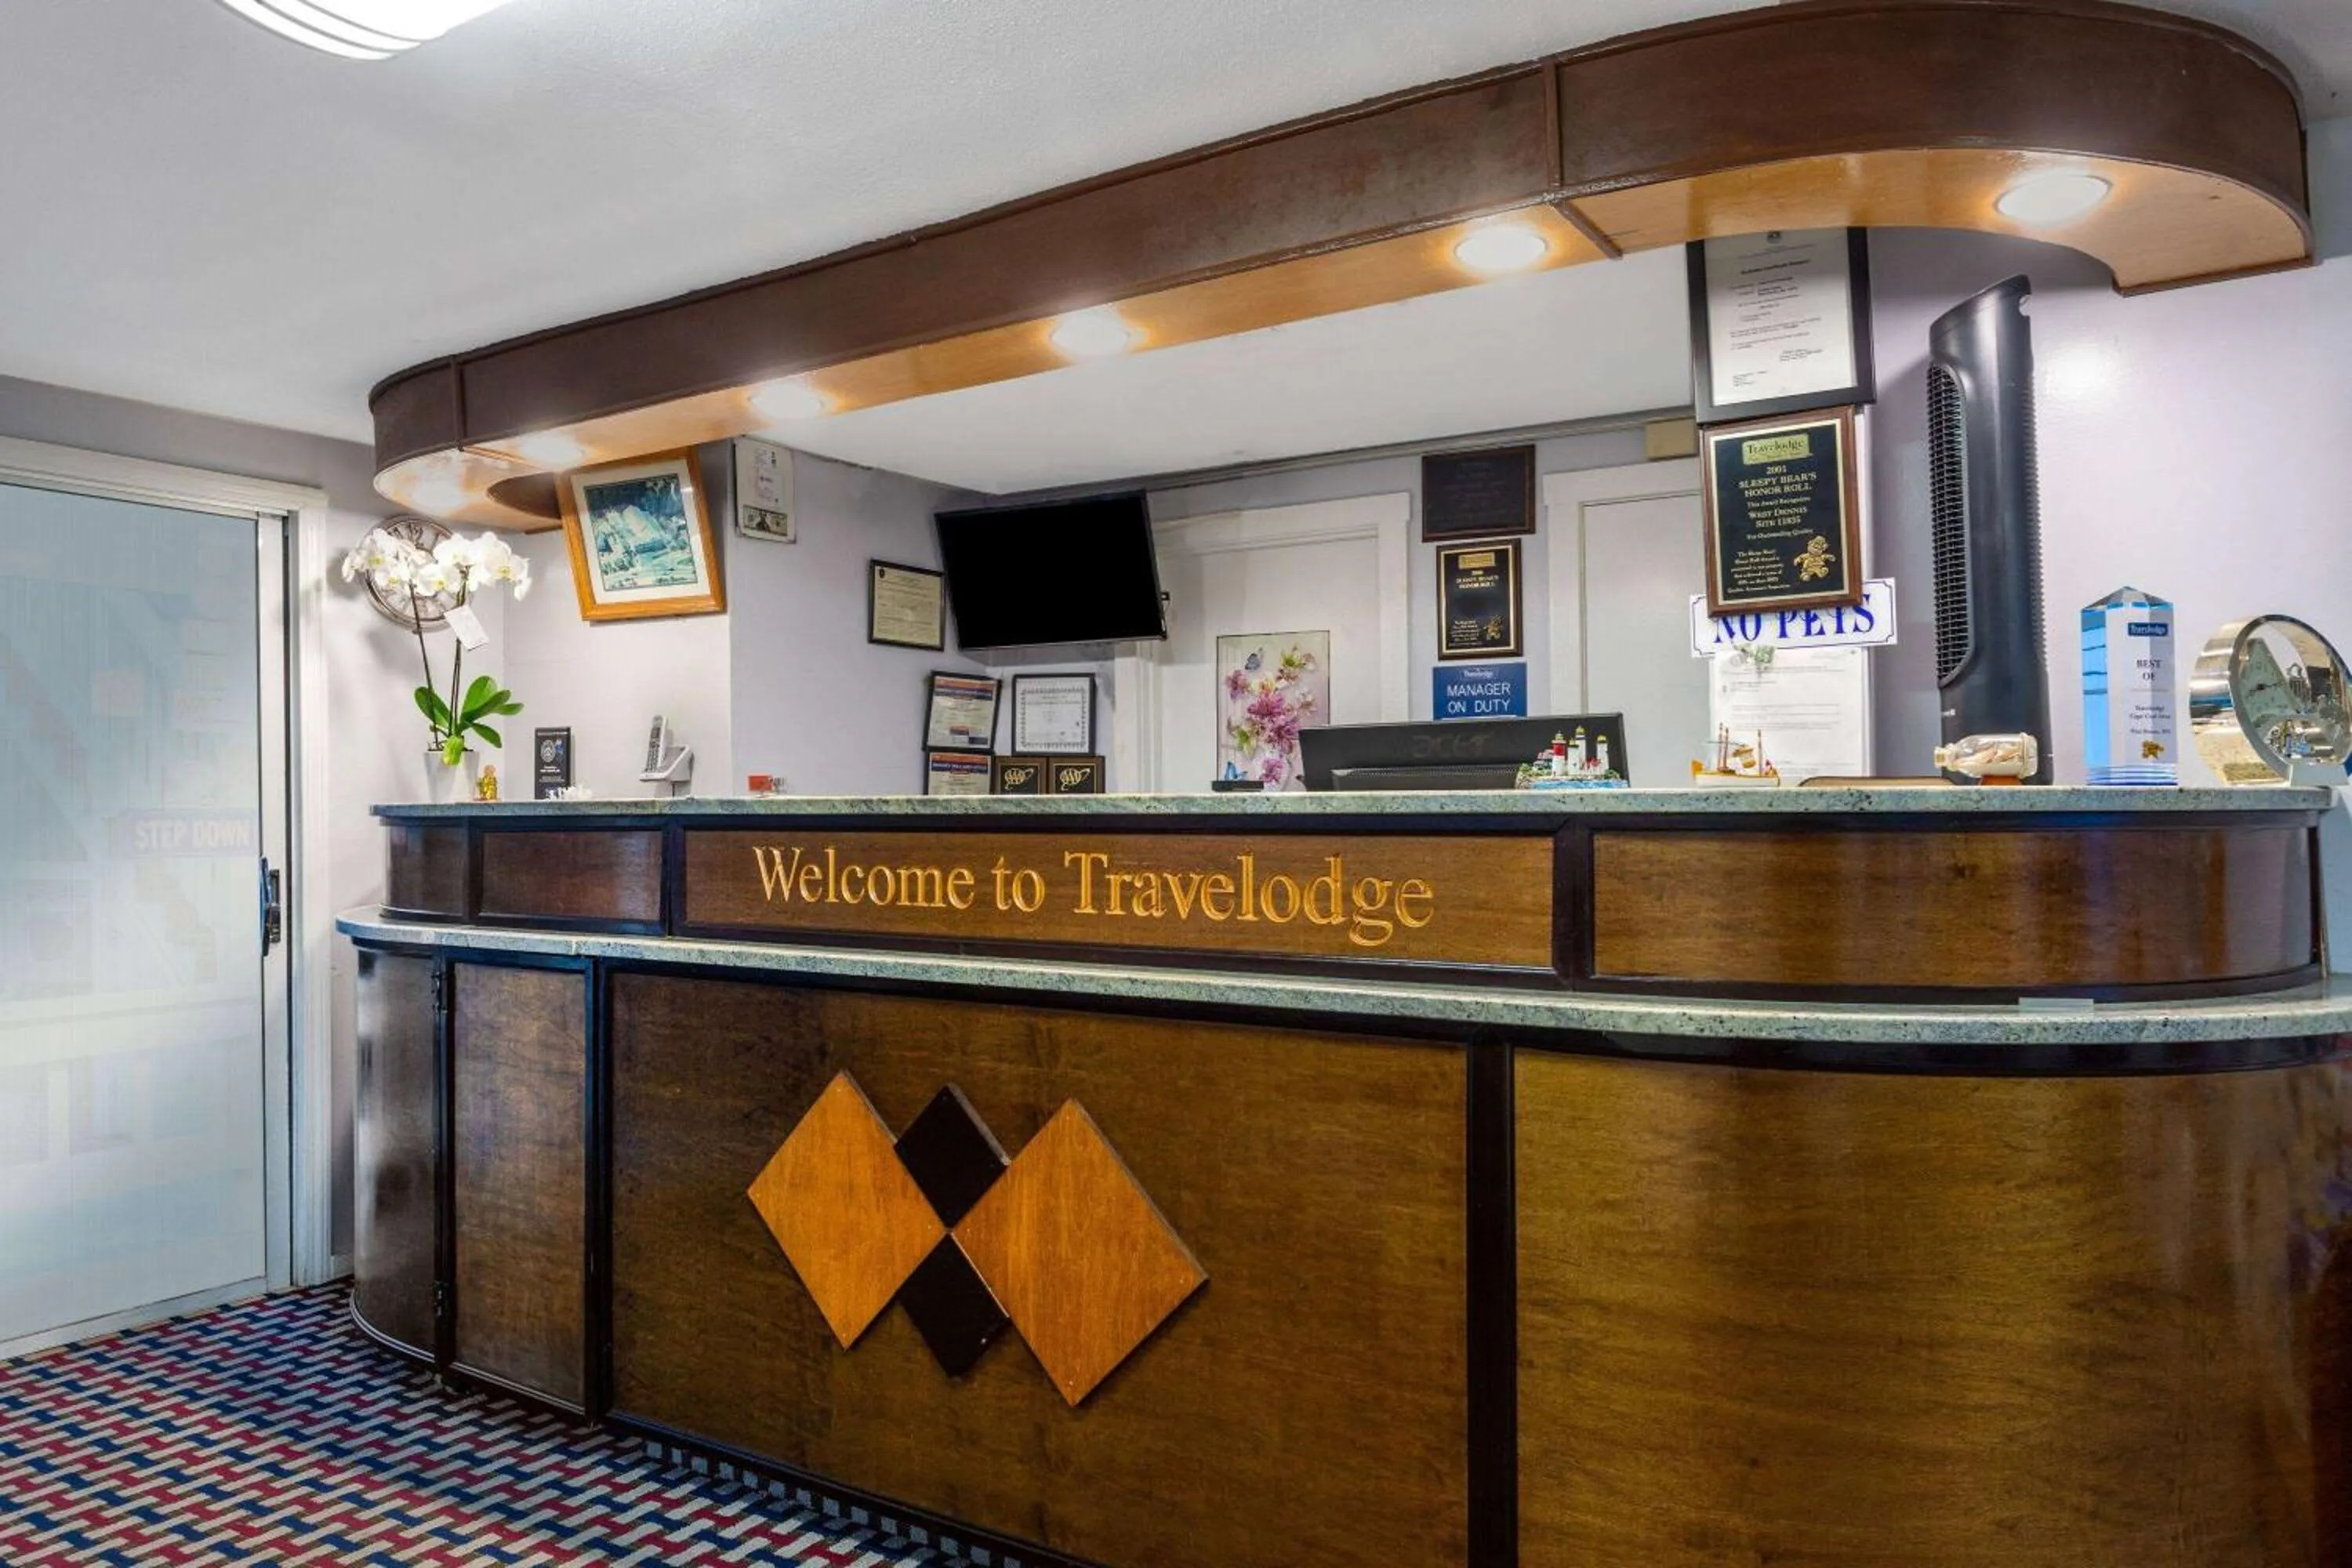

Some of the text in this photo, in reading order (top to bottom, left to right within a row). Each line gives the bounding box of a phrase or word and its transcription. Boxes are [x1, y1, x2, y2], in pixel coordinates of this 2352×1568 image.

[1747, 438, 1805, 455] Travelodge
[1744, 486, 1781, 497] HONOR
[1714, 614, 1762, 643] NO
[1446, 682, 1511, 697] MANAGER
[1448, 699, 1511, 715] ON DUTY
[135, 818, 251, 851] STEP DOWN
[753, 845, 1434, 946] Welcome to Travelodge
